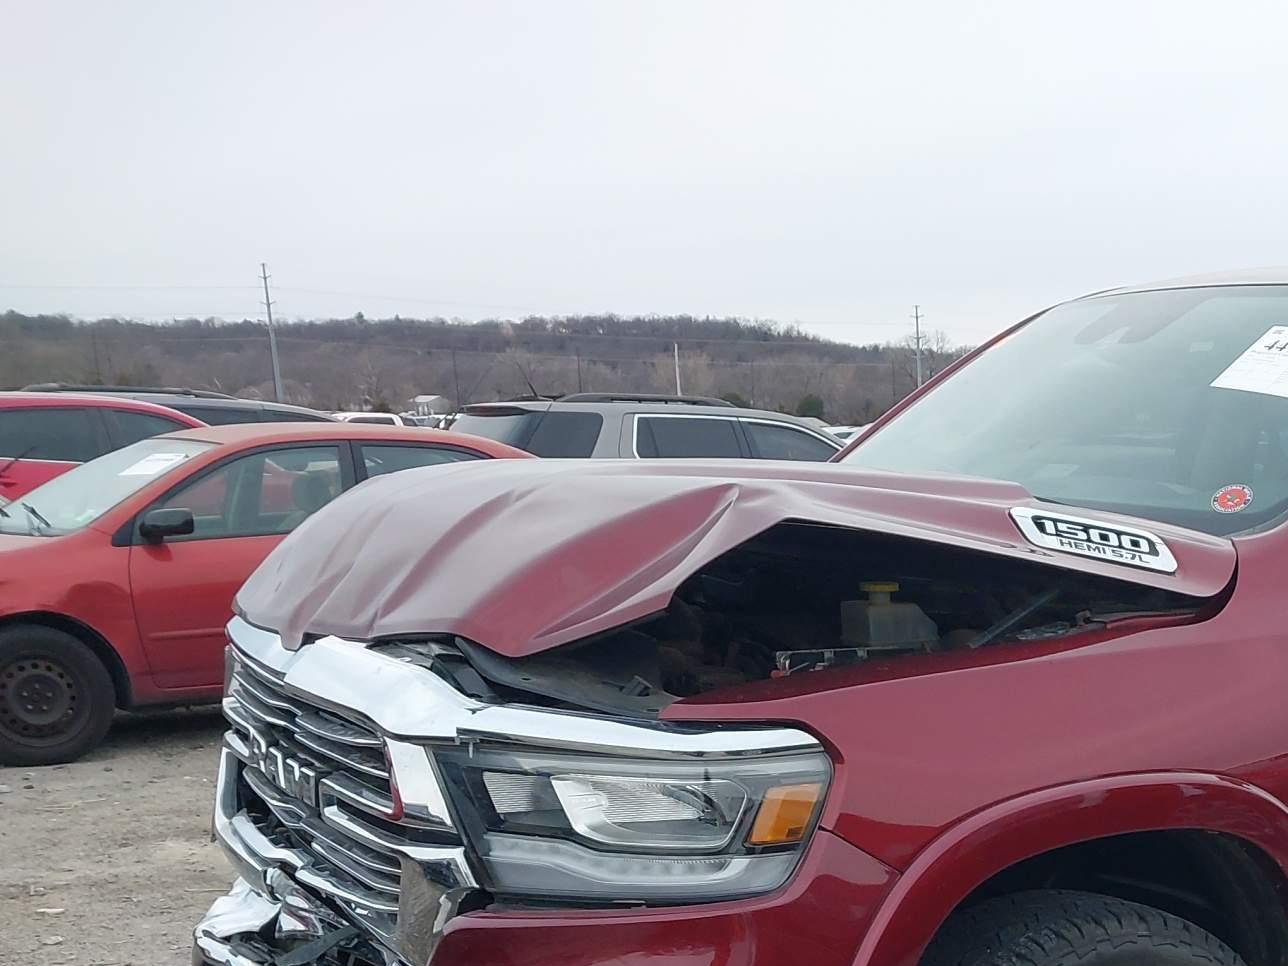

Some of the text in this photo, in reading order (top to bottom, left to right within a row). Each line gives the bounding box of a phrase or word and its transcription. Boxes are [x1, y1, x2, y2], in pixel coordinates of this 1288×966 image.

[1035, 517, 1152, 554] 1500
[1059, 538, 1151, 564] HEMI 5.7L
